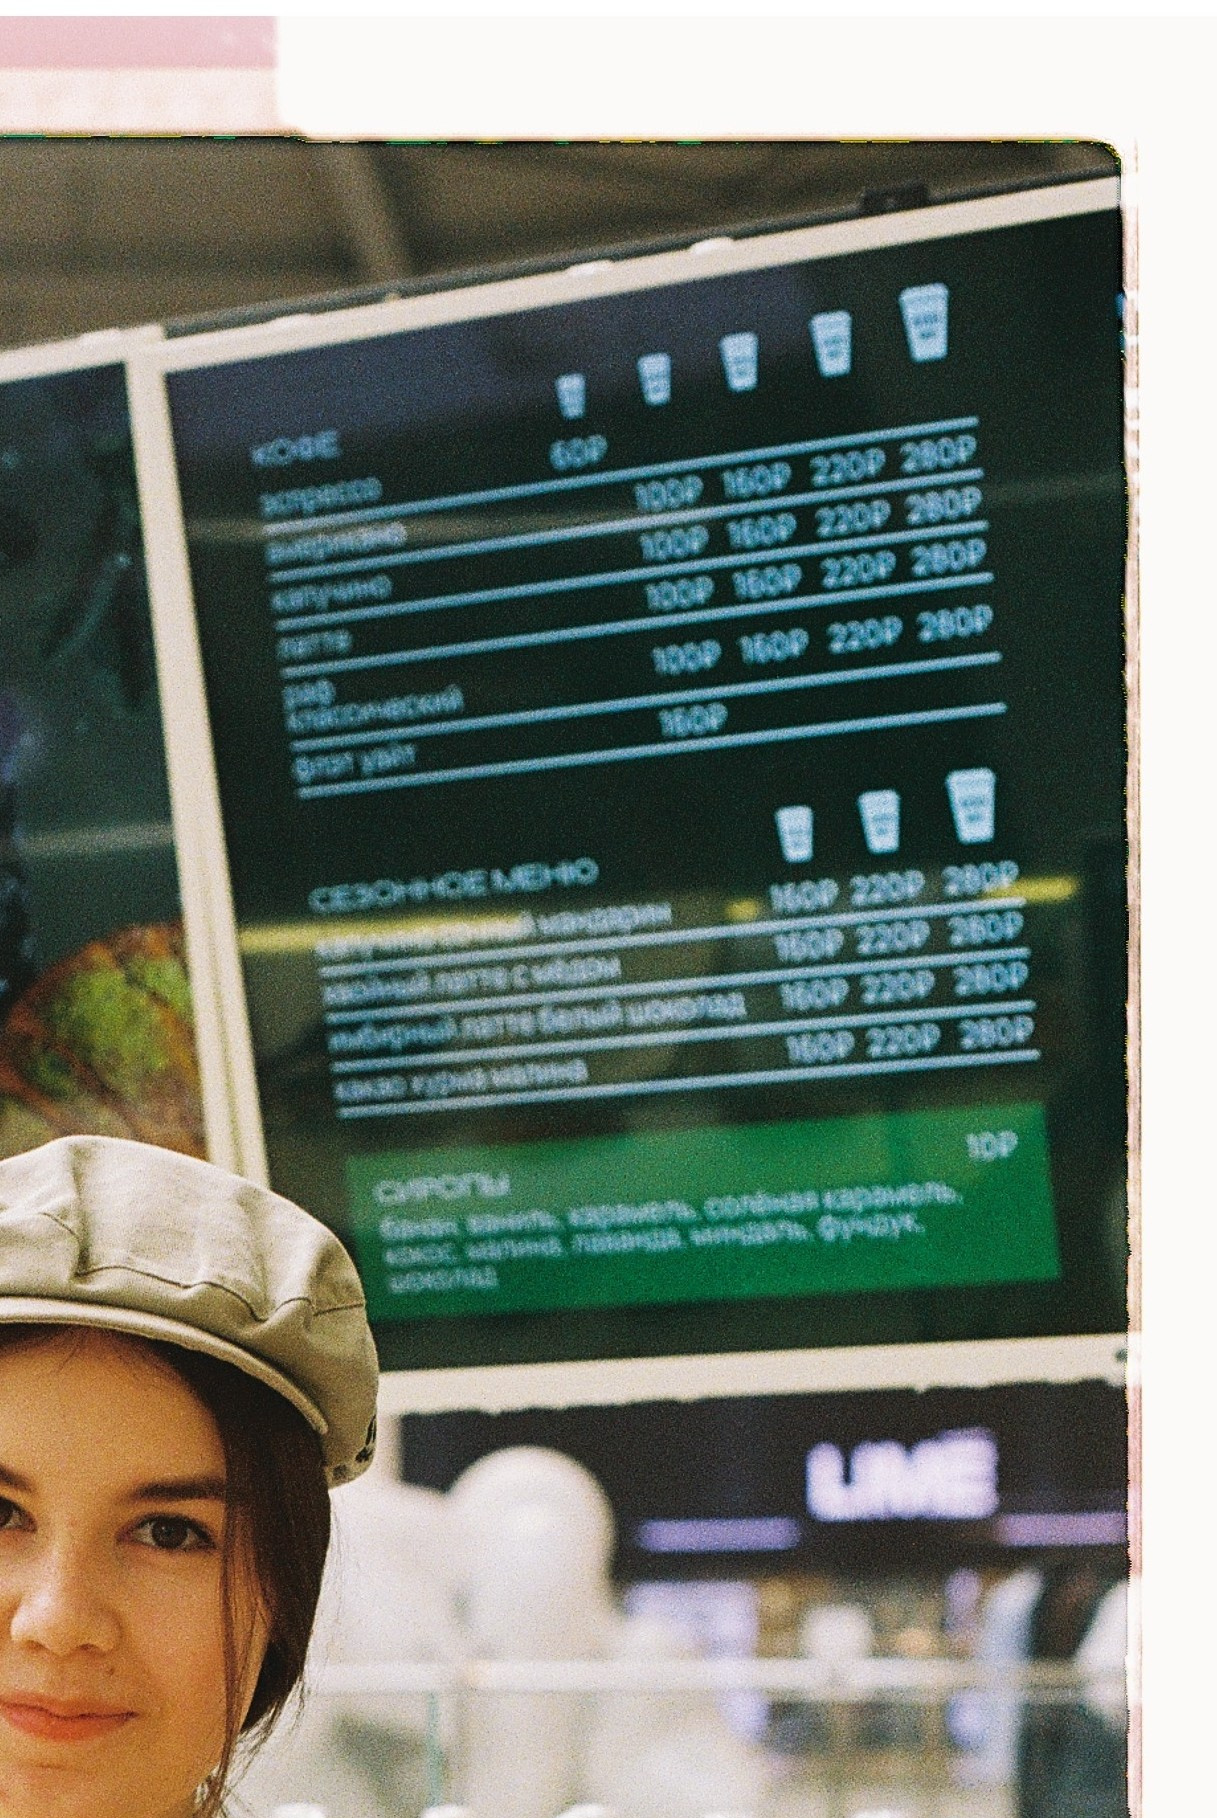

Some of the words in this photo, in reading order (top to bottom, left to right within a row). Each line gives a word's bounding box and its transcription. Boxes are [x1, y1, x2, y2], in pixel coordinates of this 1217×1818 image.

[251, 430, 341, 466] КОФЕ
[271, 574, 392, 612] капучино
[277, 629, 352, 660] латте
[287, 683, 464, 732] классический
[309, 868, 486, 914] СЕЗОННОЕ
[491, 856, 599, 892] МЕНЮ
[536, 902, 672, 936] мандарин
[435, 965, 508, 996] латте
[513, 965, 530, 988] с
[329, 1013, 457, 1053] имбирный
[461, 1012, 533, 1042] латте
[537, 998, 623, 1035] белый
[626, 992, 746, 1027] шоколад
[335, 1075, 406, 1102] какао
[489, 1058, 589, 1088] малина
[372, 1170, 510, 1206] СИРОПЫ
